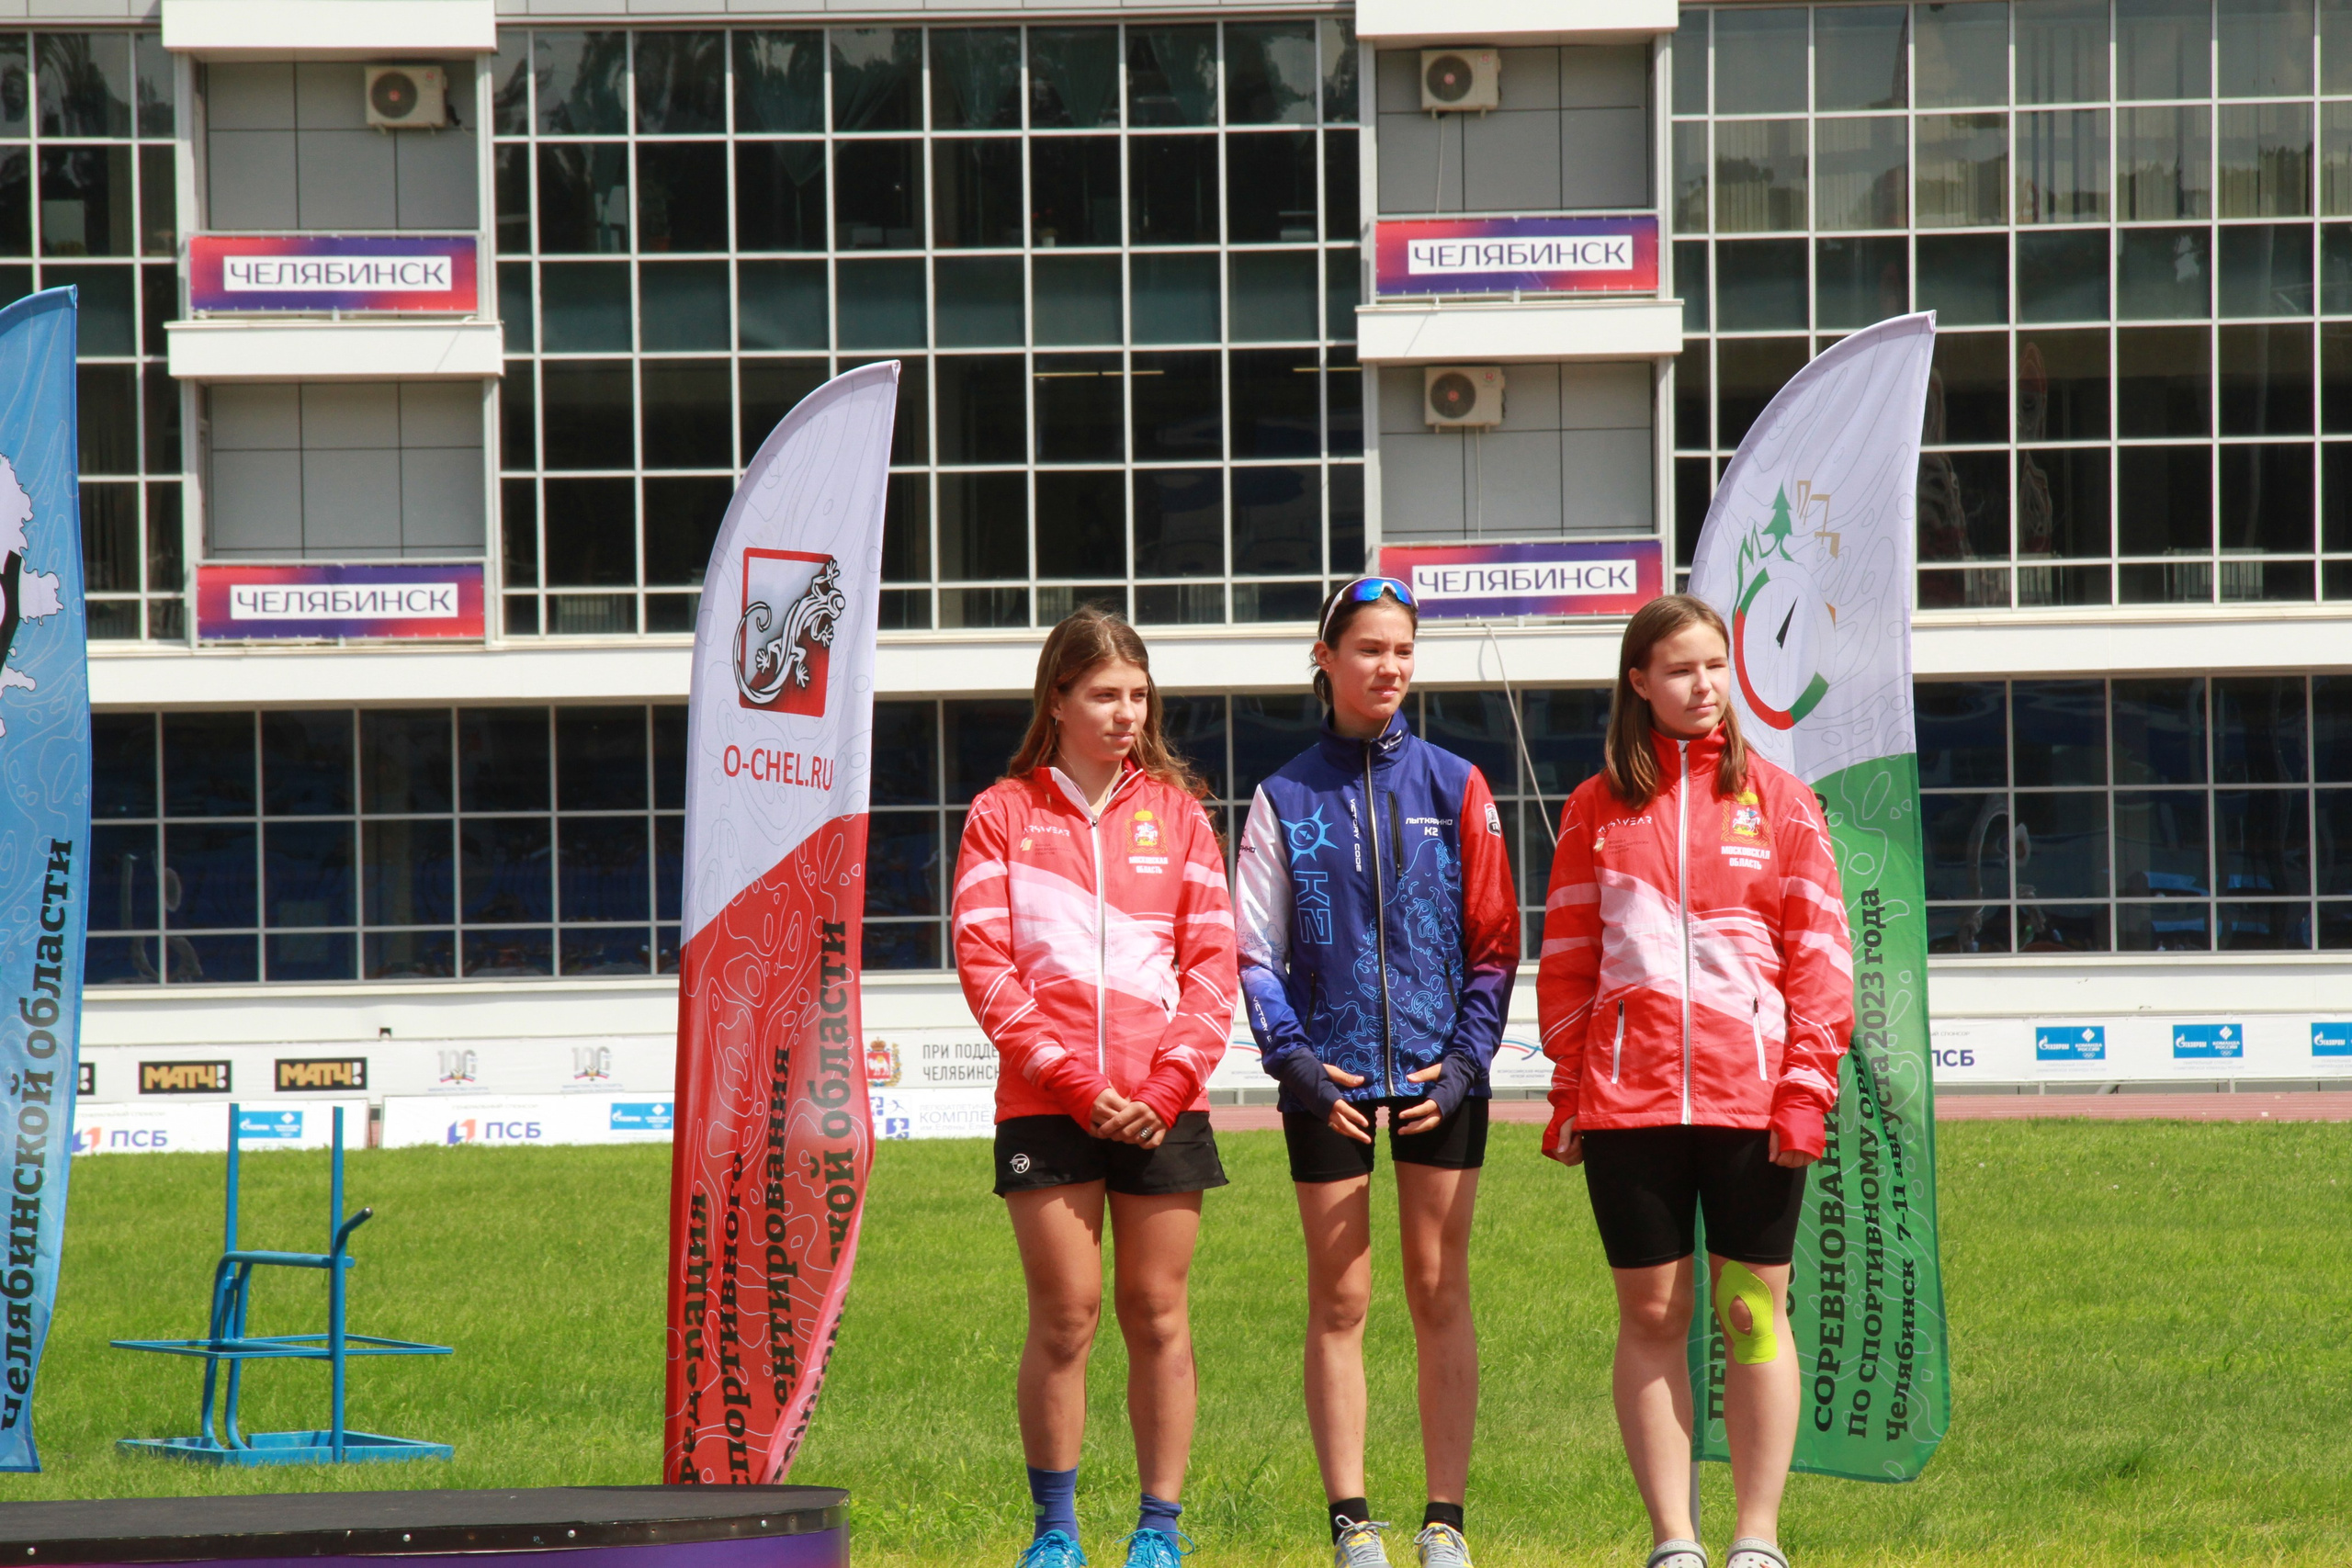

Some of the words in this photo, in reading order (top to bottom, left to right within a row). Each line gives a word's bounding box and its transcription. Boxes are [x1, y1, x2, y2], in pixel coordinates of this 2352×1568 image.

[1414, 242, 1626, 267] ЧЕЛЯБИНСК
[230, 262, 445, 285] ЧЕЛЯБИНСК
[1418, 565, 1630, 592] ЧЕЛЯБИНСК
[236, 589, 451, 613] ЧЕЛЯБИНСК
[723, 745, 834, 791] O-CHEL.RU
[1354, 843, 1363, 872] CODE
[1721, 846, 1770, 860] МОСКОВСКАЯ
[1729, 858, 1762, 870] ОБЛАСТЬ
[1860, 887, 1886, 964] года
[18, 838, 73, 1059] области
[1860, 971, 1887, 1049] 2023
[807, 919, 852, 1139] области
[922, 1043, 950, 1059] ПРИ
[143, 1065, 227, 1089] МАТЧ!
[279, 1062, 362, 1087] МАТЧ!
[485, 1122, 542, 1139] ПСБ
[1871, 1055, 1903, 1179] августа
[110, 1129, 168, 1147] ПСБ
[1893, 1184, 1912, 1241] 7-11
[0, 1067, 53, 1430] челябинской
[1859, 1124, 1883, 1382] СПОРТИВНОМУ
[1886, 1258, 1915, 1441] Челябинск
[1848, 1389, 1871, 1438] ПО
